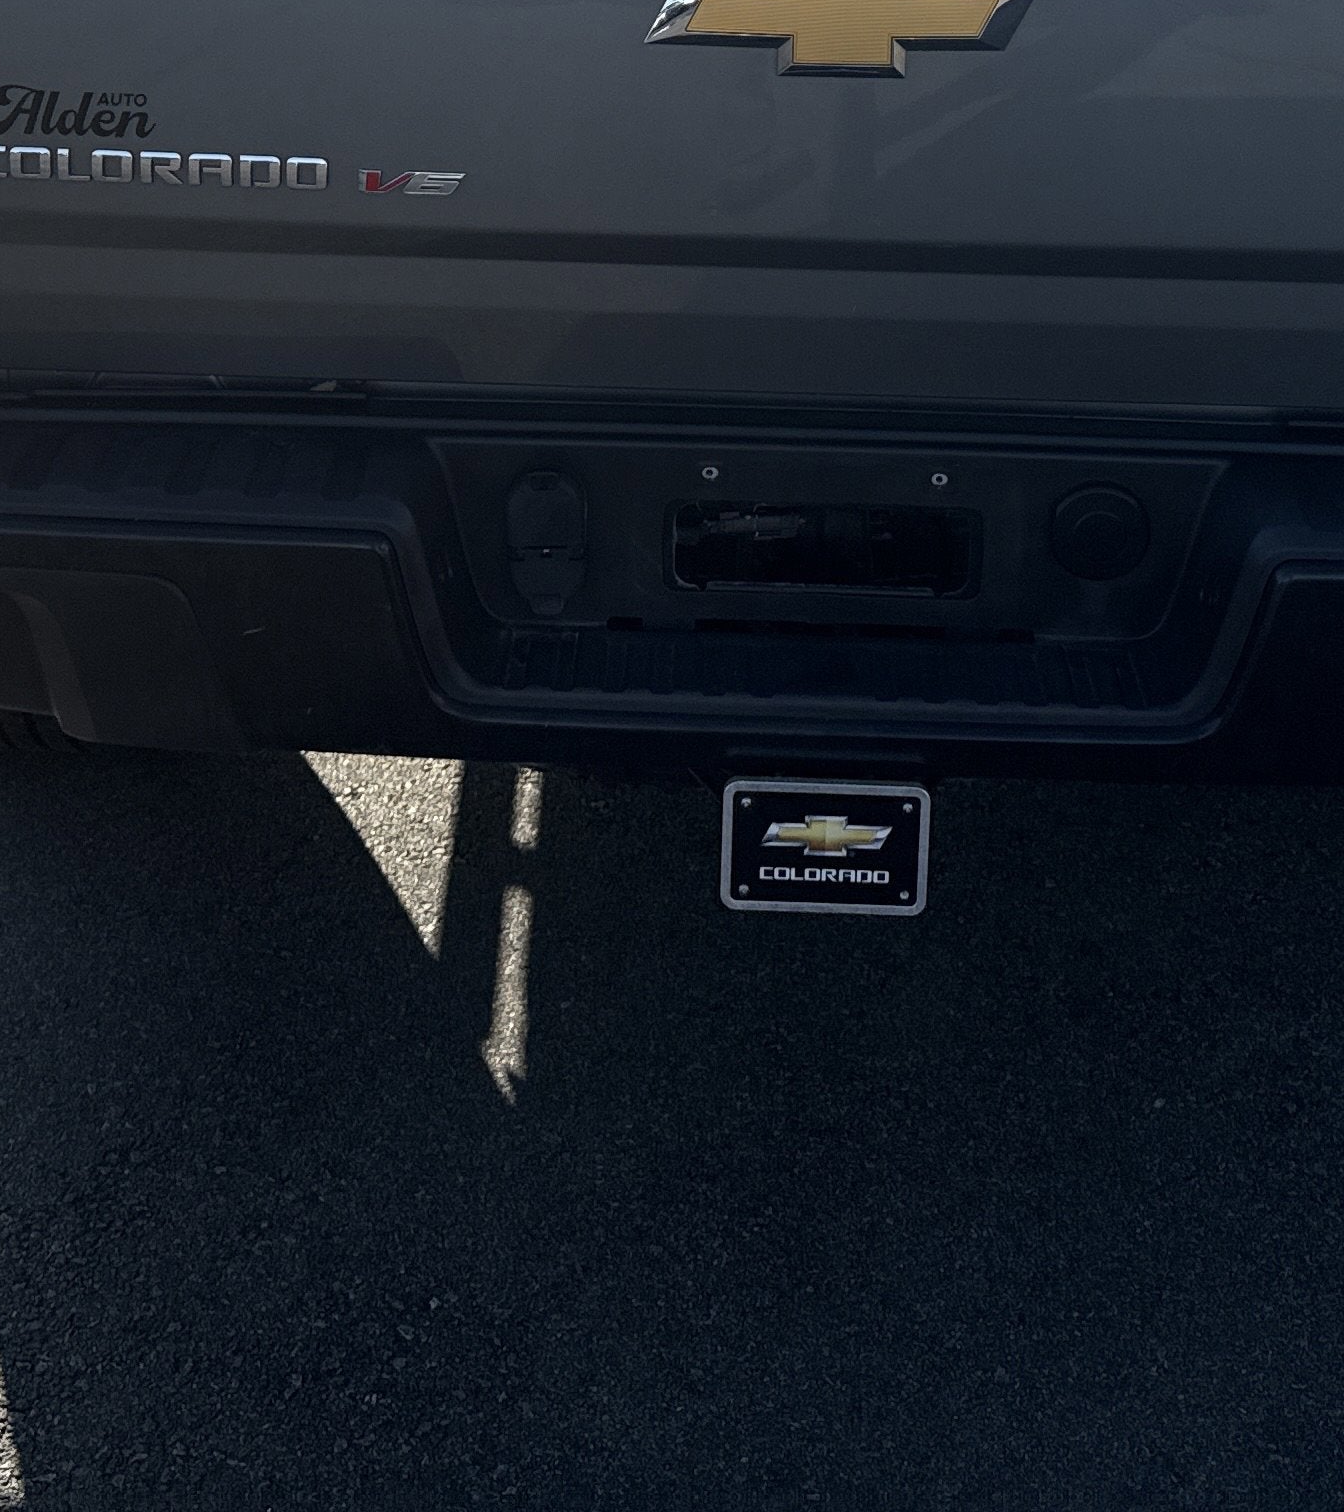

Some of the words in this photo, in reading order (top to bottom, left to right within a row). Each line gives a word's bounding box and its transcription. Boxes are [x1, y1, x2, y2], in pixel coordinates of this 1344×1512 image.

[97, 92, 148, 107] AUTO
[358, 168, 466, 196] V6
[759, 866, 890, 884] COLORADO
